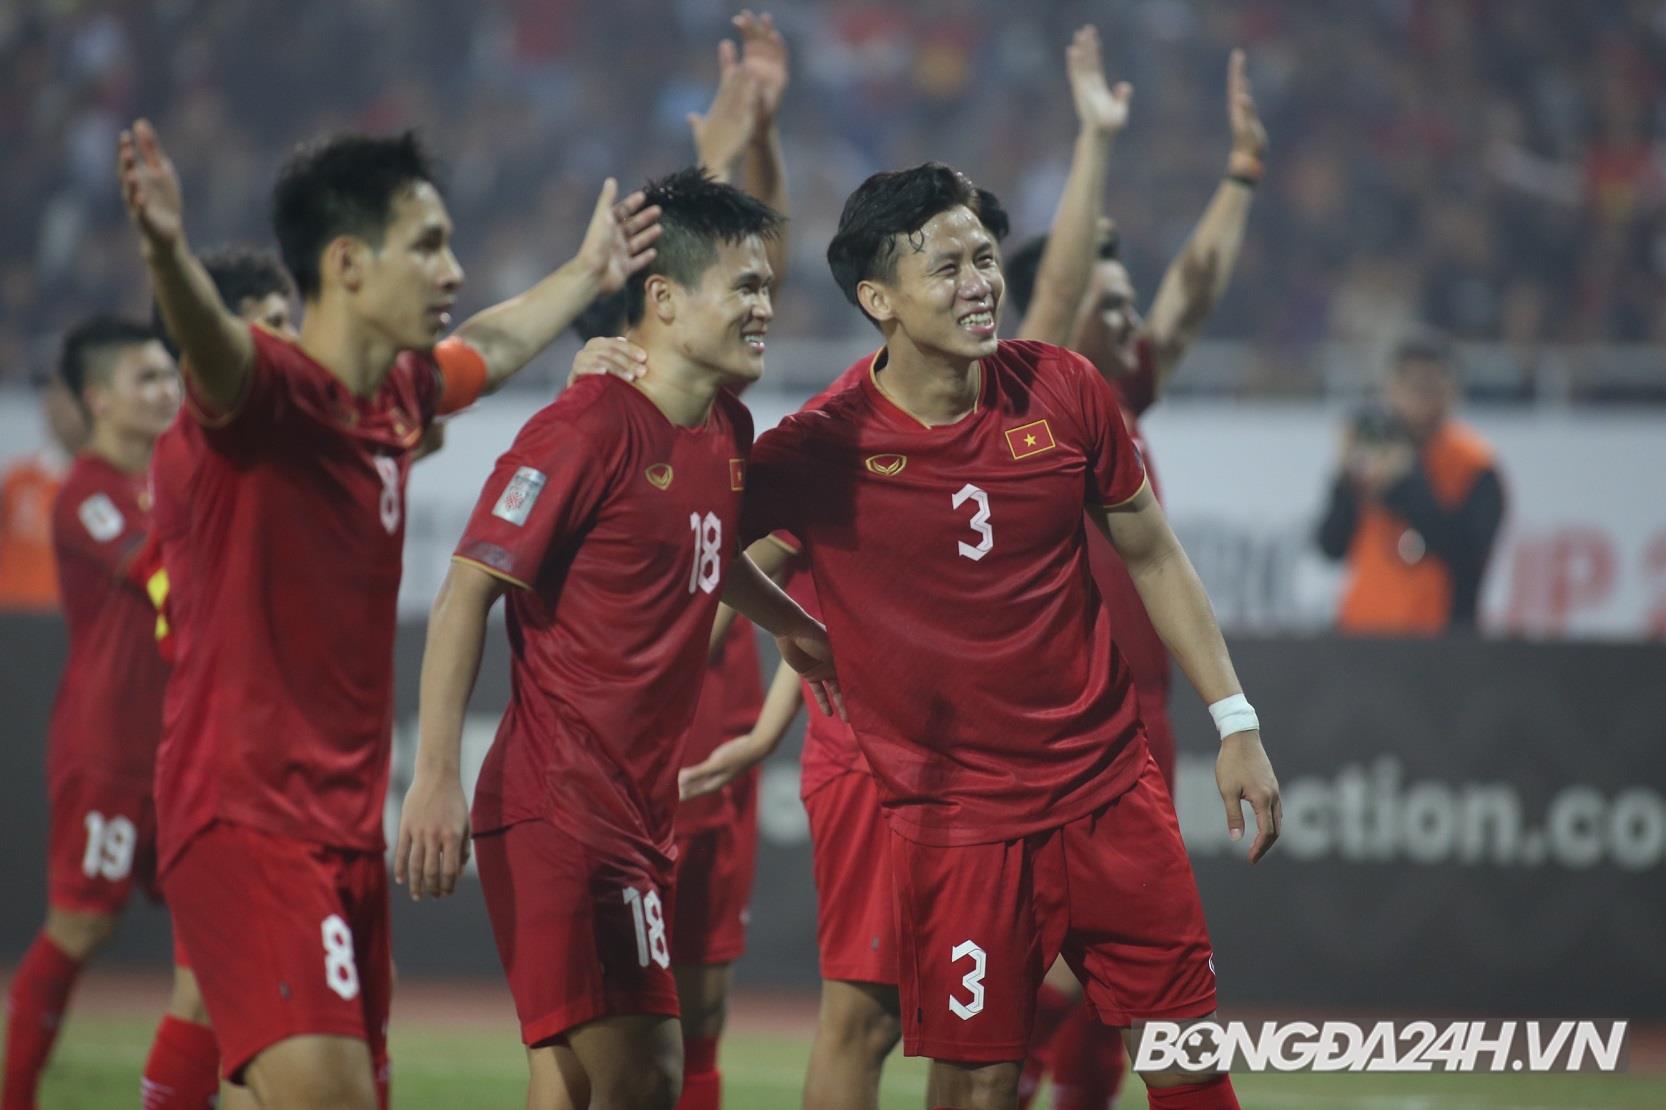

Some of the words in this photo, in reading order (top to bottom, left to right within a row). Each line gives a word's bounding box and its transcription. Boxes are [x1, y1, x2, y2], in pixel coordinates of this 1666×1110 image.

[373, 455, 400, 535] 8
[951, 483, 994, 562] 3
[688, 511, 722, 594] 18
[82, 809, 137, 881] 19
[320, 912, 359, 1001] 8
[622, 886, 670, 970] 18
[949, 938, 987, 1021] 3
